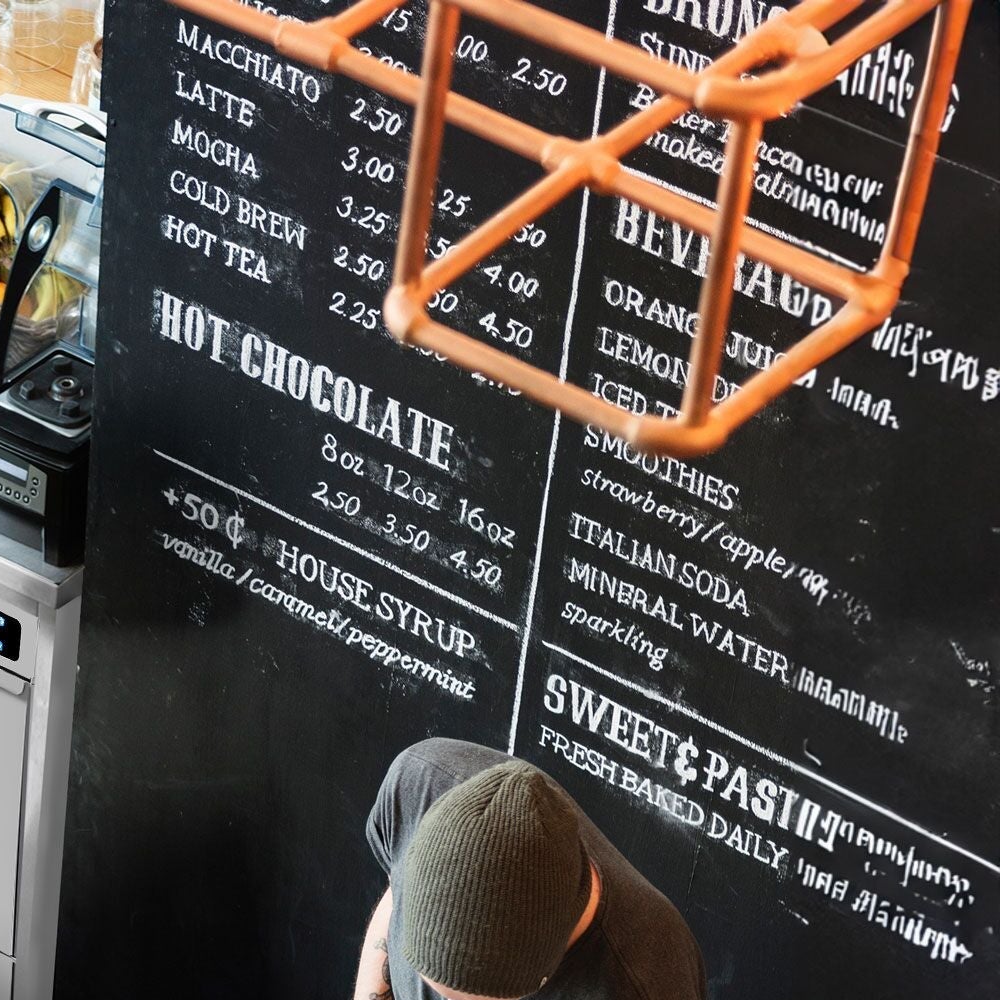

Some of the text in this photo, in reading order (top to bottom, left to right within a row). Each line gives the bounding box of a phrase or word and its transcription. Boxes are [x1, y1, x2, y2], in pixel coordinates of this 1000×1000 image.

[175, 71, 256, 128] LATTE
[341, 146, 395, 184] 3.00
[177, 19, 321, 103] MACCHIATO
[349, 98, 403, 136] 2.50
[512, 58, 567, 96] 2.50
[170, 171, 229, 216] COLD
[237, 197, 307, 250] BREW
[333, 245, 385, 281] 2.50
[171, 119, 260, 179] MOCHA
[336, 196, 390, 234] 3.25
[483, 263, 540, 298] 4.00
[164, 215, 381, 330] HOT TEA 2.25
[160, 289, 455, 471] HOT CHOCOLATE
[591, 373, 647, 417] ICED
[584, 424, 739, 510] SMOOTHIES
[276, 539, 373, 612] HOUSE
[376, 592, 475, 657] SYRUP
[382, 513, 430, 552] 3.50
[450, 551, 502, 586] 4.50
[570, 512, 675, 580] ITALIAN
[680, 564, 750, 617] SODA
[560, 601, 669, 671] sparkling
[568, 558, 790, 683] MINERAL WATER
[707, 812, 789, 870] DAILY
